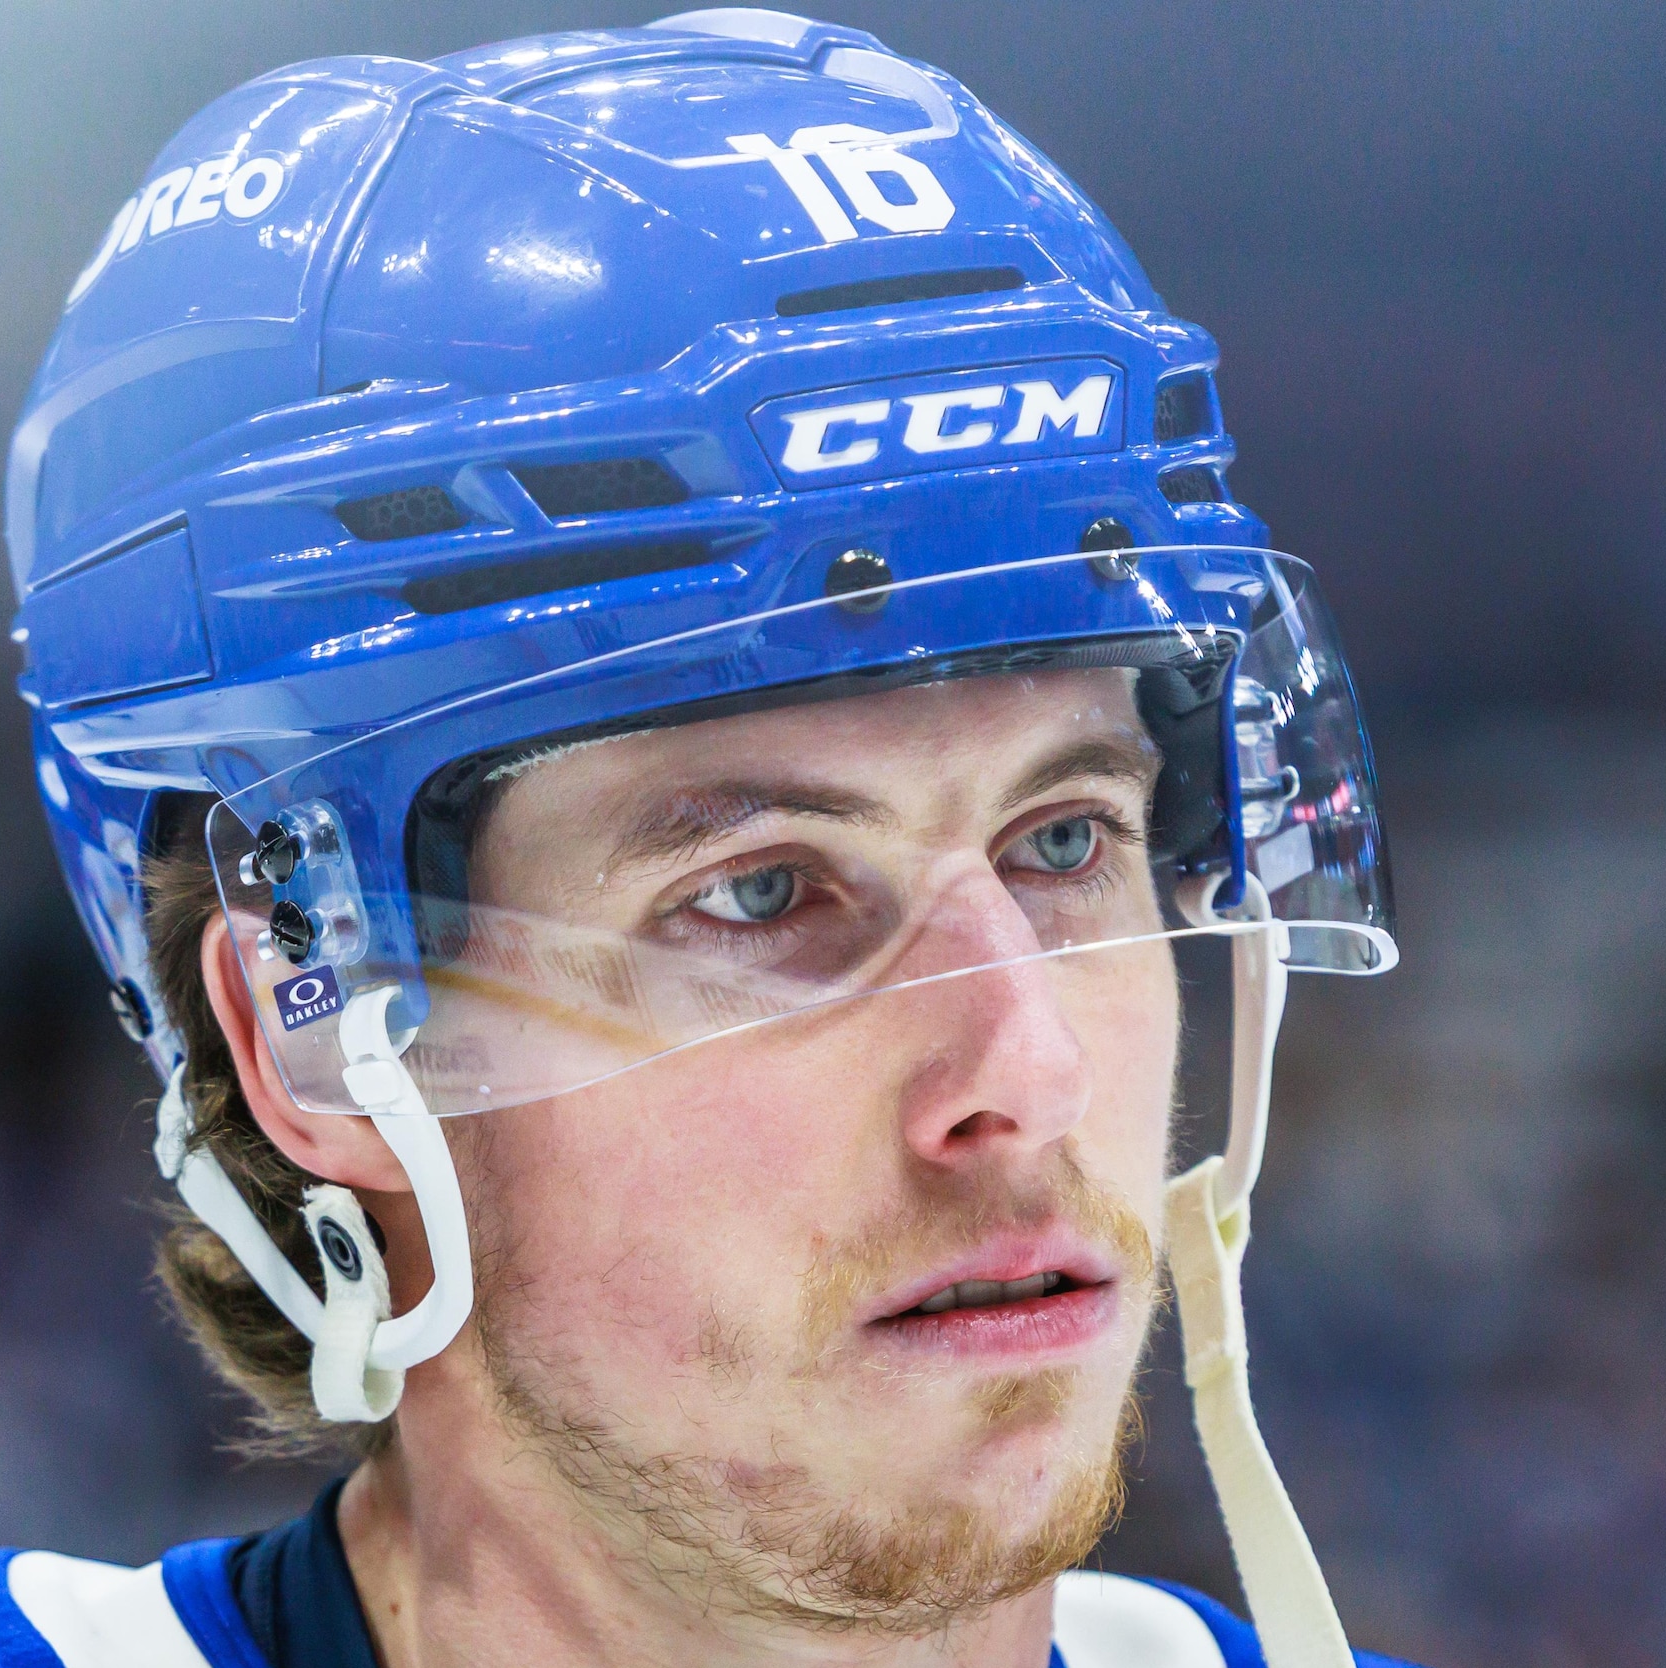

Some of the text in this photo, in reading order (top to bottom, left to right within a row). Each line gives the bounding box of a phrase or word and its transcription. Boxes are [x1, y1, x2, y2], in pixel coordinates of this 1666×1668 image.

[725, 122, 956, 244] 16
[780, 374, 1113, 473] CCM
[286, 996, 337, 1025] OAKLEY
